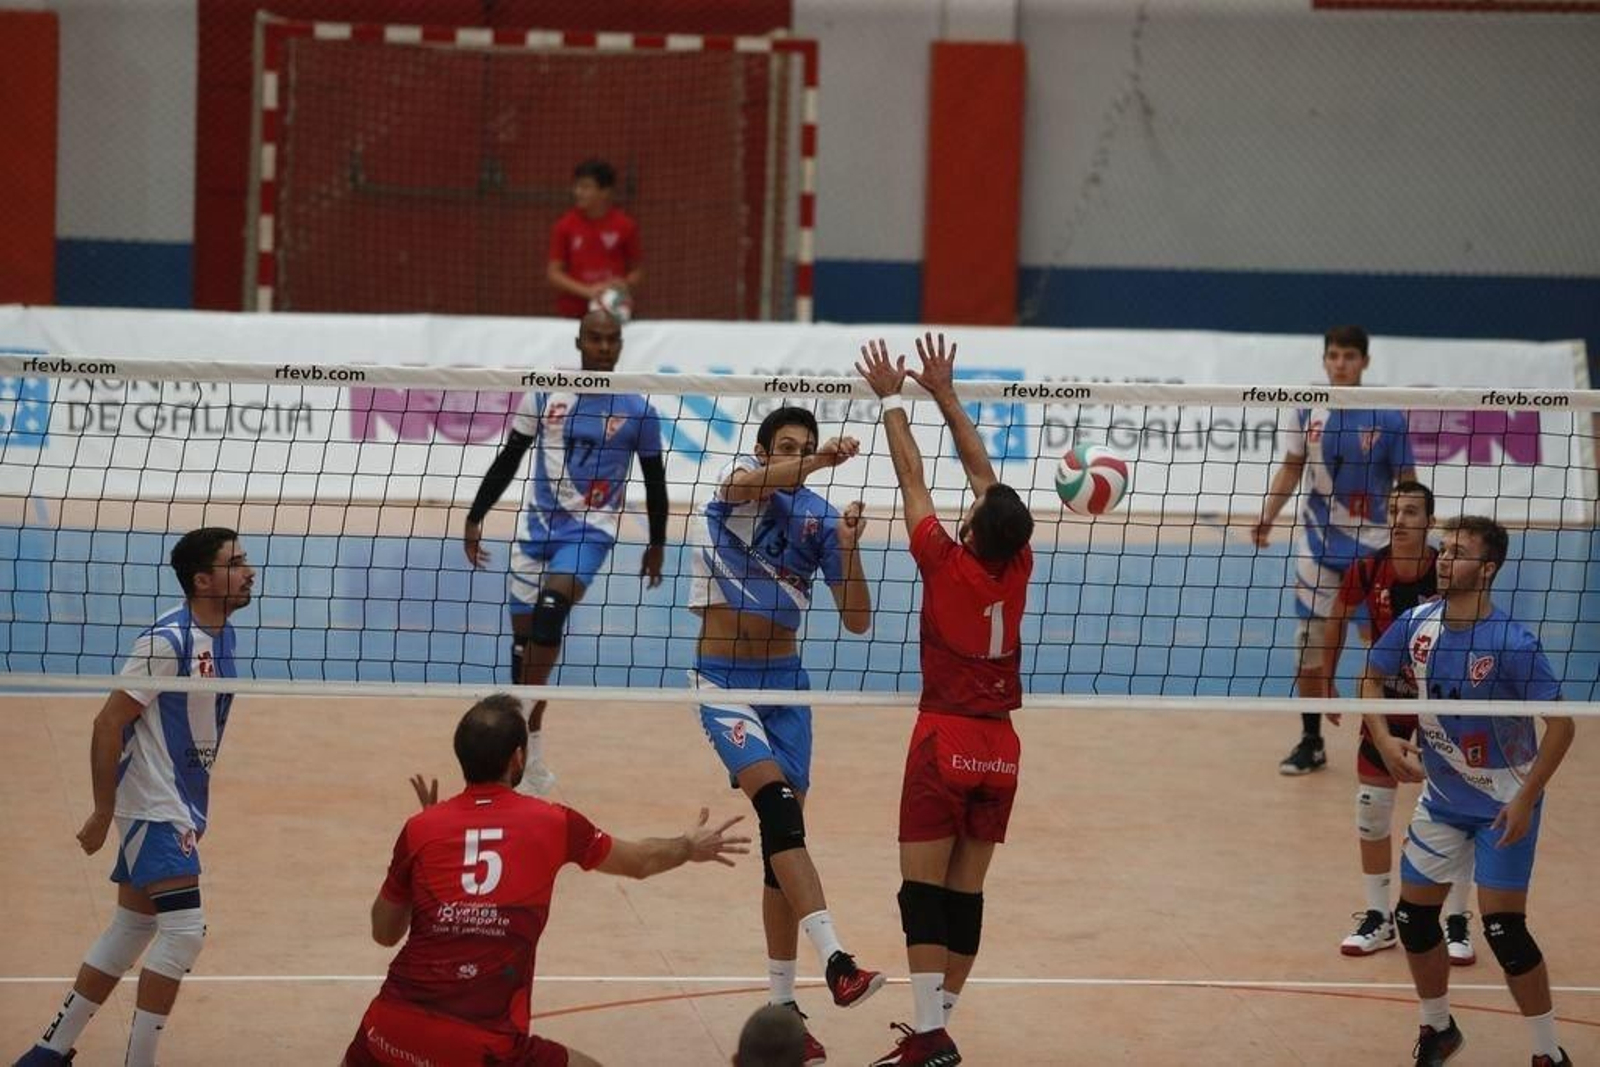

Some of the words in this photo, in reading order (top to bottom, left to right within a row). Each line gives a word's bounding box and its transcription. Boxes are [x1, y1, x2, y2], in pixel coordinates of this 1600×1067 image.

[22, 358, 116, 375] rfevb.com
[274, 364, 366, 382] rfevb.com
[521, 371, 611, 388] rfevb.com
[764, 377, 851, 393] rfevb.com
[1002, 383, 1091, 399] rfevb.com
[1242, 386, 1329, 403] rfevb.com
[1481, 389, 1569, 406] rfevb.com
[67, 401, 119, 432] DE
[134, 402, 313, 434] GALICIA
[1044, 416, 1093, 450] DE
[1108, 418, 1279, 450] GALICIA
[983, 601, 1005, 660] 1
[461, 828, 504, 895] 5
